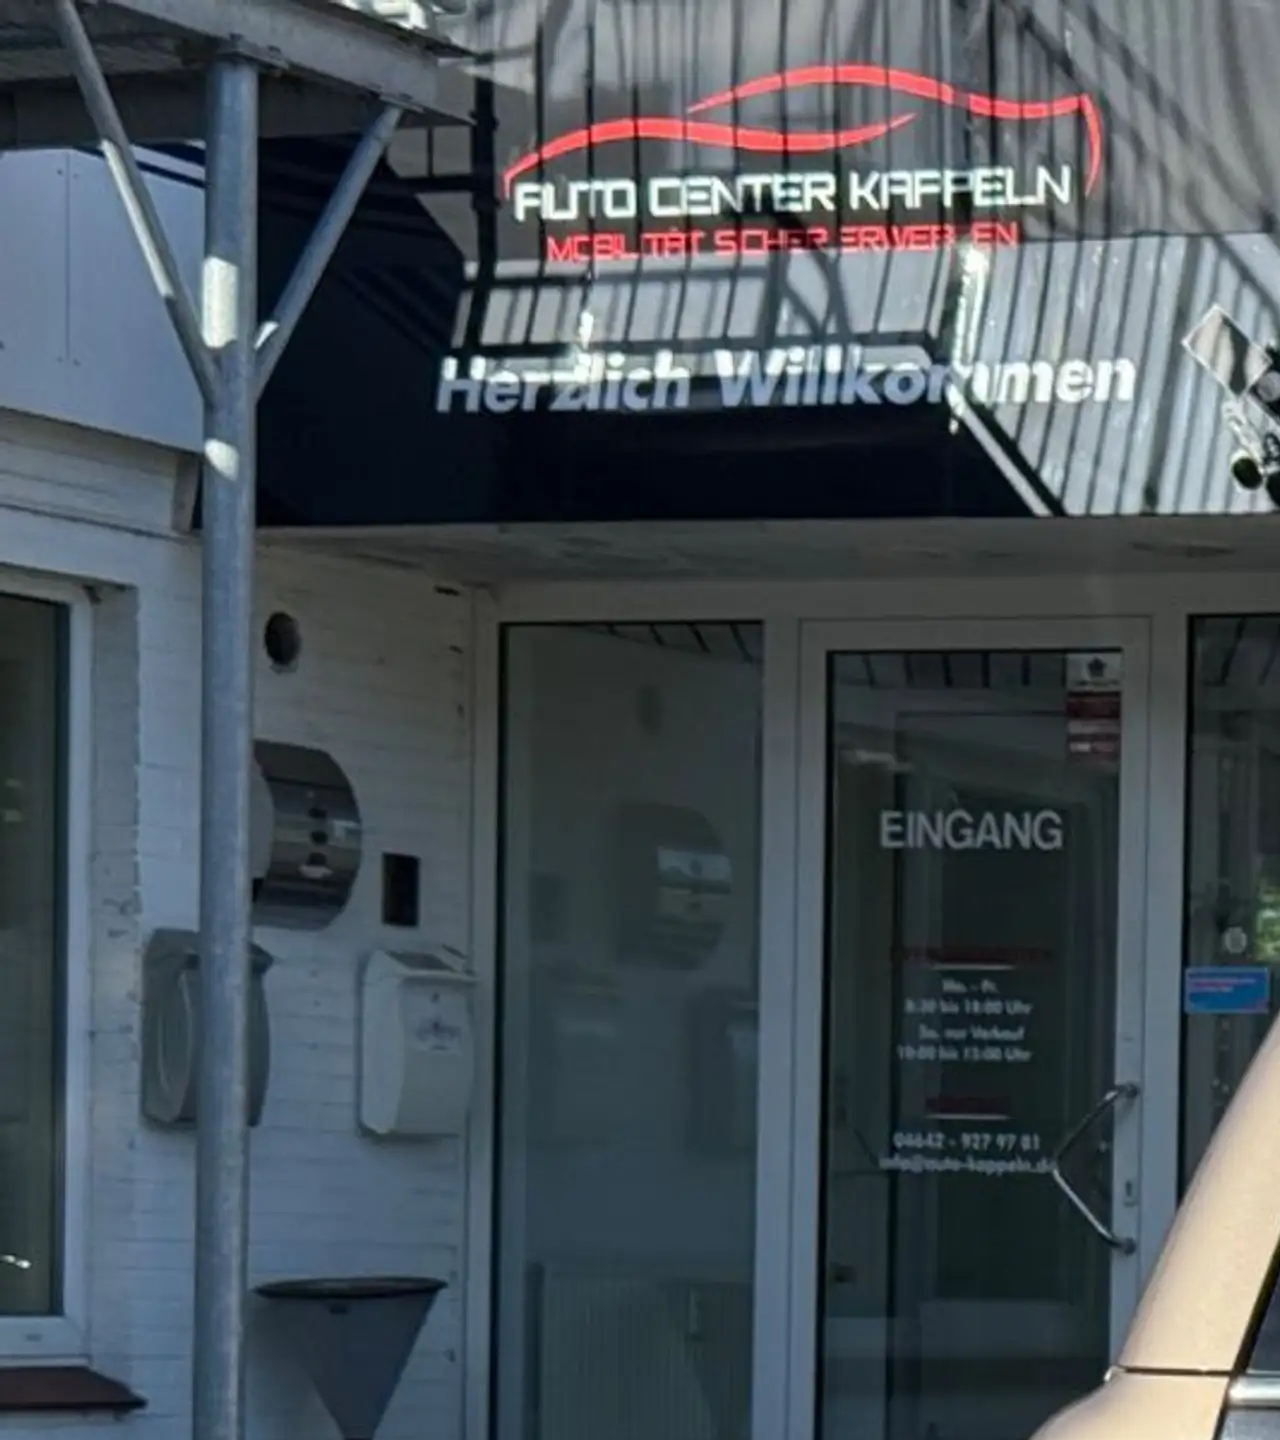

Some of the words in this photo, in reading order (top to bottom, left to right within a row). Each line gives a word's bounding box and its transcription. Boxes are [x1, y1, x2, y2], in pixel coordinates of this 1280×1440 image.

[515, 179, 637, 222] AUTO
[649, 172, 836, 213] CENTER
[850, 165, 1071, 210] KAPPELN
[436, 352, 690, 413] Herzlich
[713, 345, 1136, 407] Willkommen
[879, 808, 1064, 851] EINGANG
